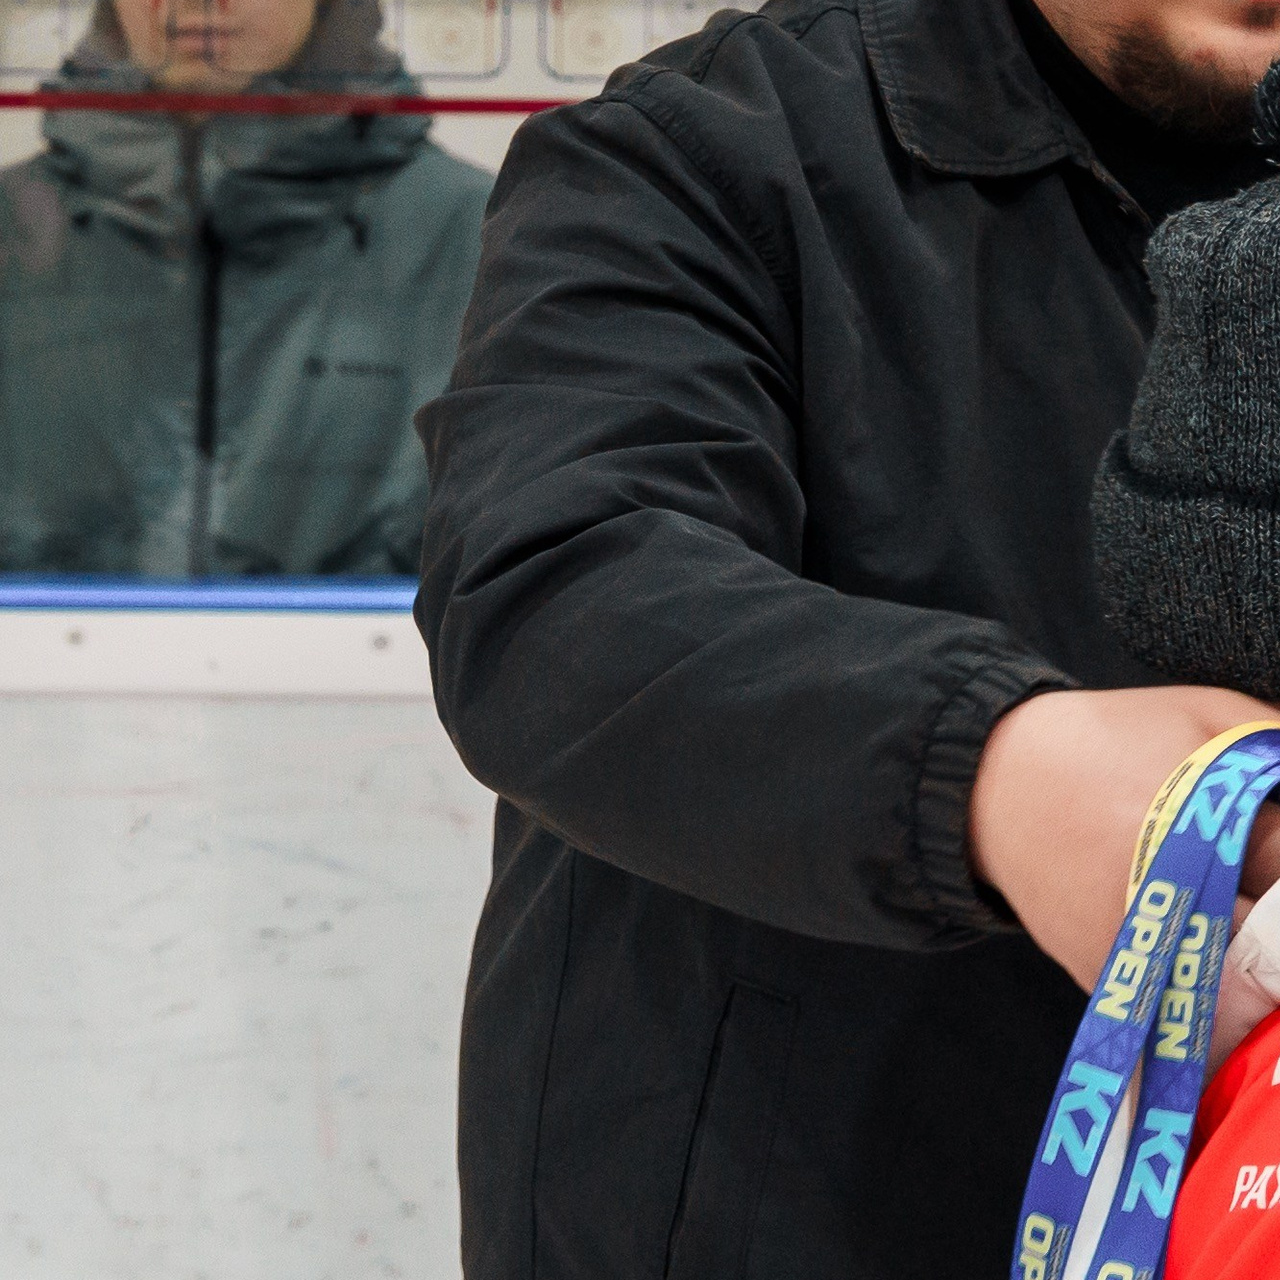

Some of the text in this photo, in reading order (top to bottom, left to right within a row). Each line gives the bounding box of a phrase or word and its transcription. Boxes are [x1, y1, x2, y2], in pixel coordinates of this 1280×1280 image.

[1173, 750, 1268, 842] KZ
[1095, 880, 1177, 1021] OPEN
[1042, 1060, 1125, 1177] KZ
[1122, 1106, 1193, 1221] KZ
